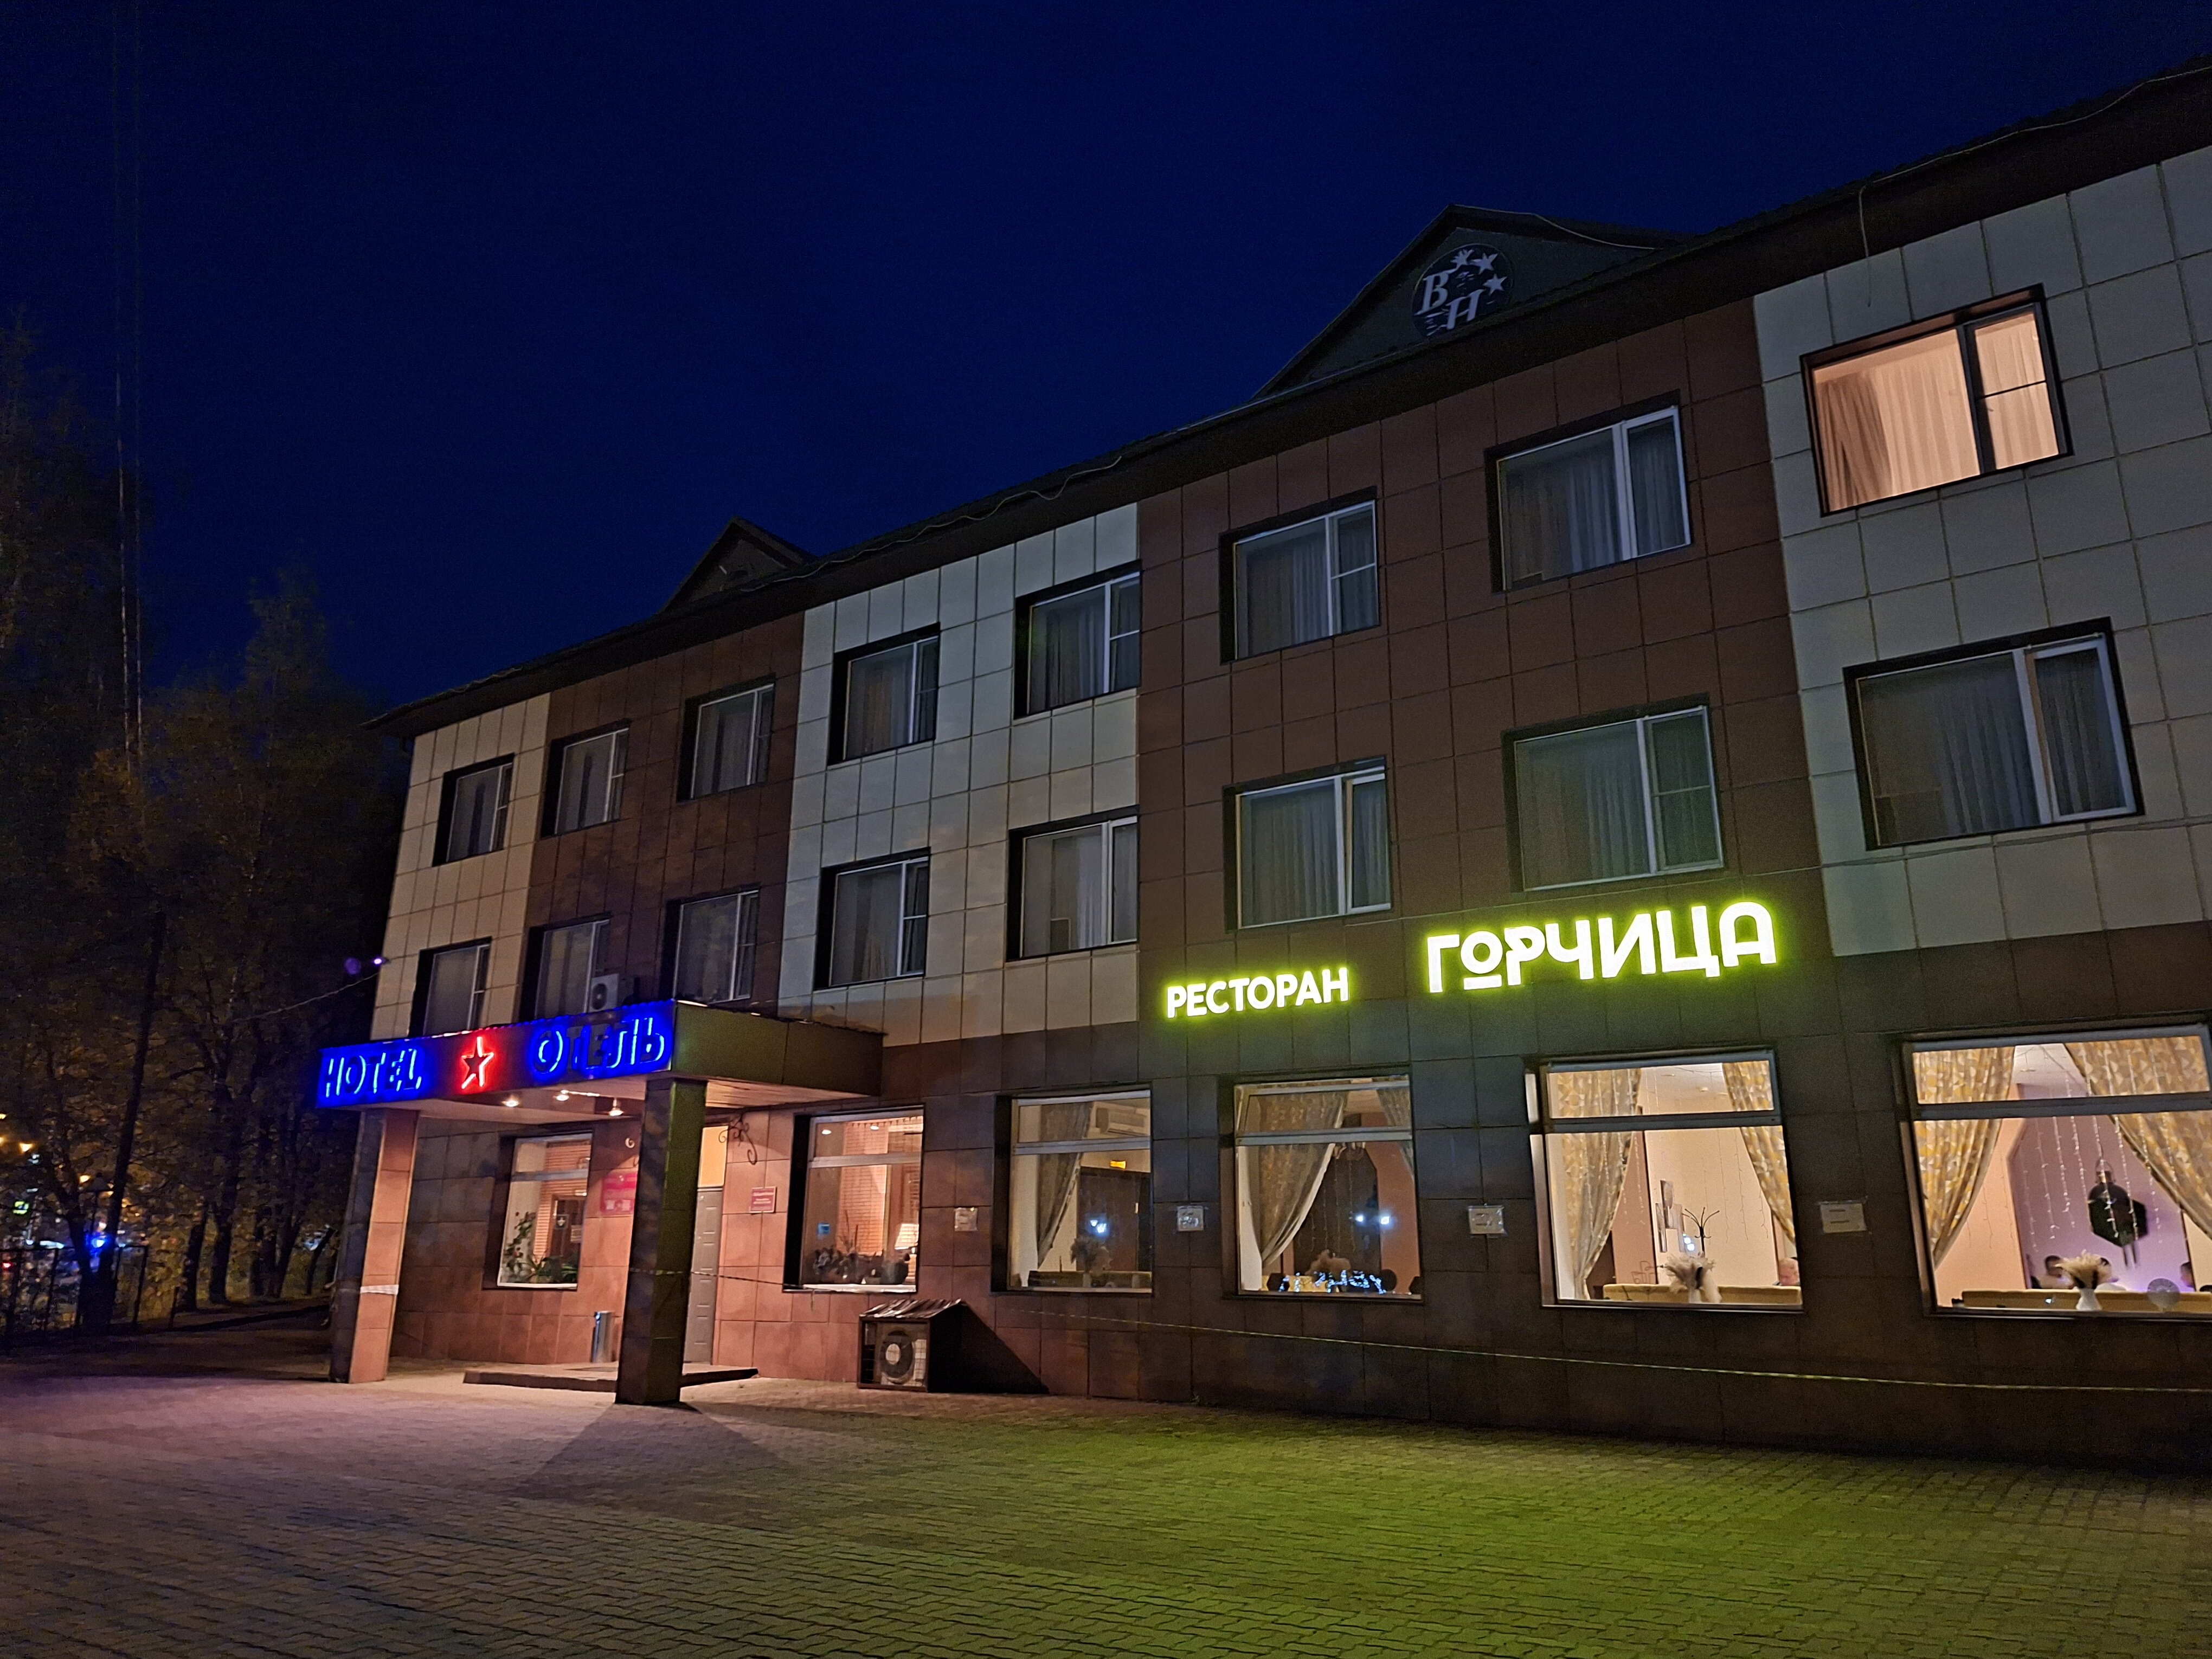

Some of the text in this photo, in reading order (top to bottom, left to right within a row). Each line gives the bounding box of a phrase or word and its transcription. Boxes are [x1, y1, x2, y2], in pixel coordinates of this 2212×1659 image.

[1427, 902, 1777, 993] ГОРЧИЦА
[1167, 967, 1349, 1018] РЕСТОРАН
[533, 1017, 666, 1075] ОТЕЛЬ
[325, 1049, 422, 1098] HOTEL
